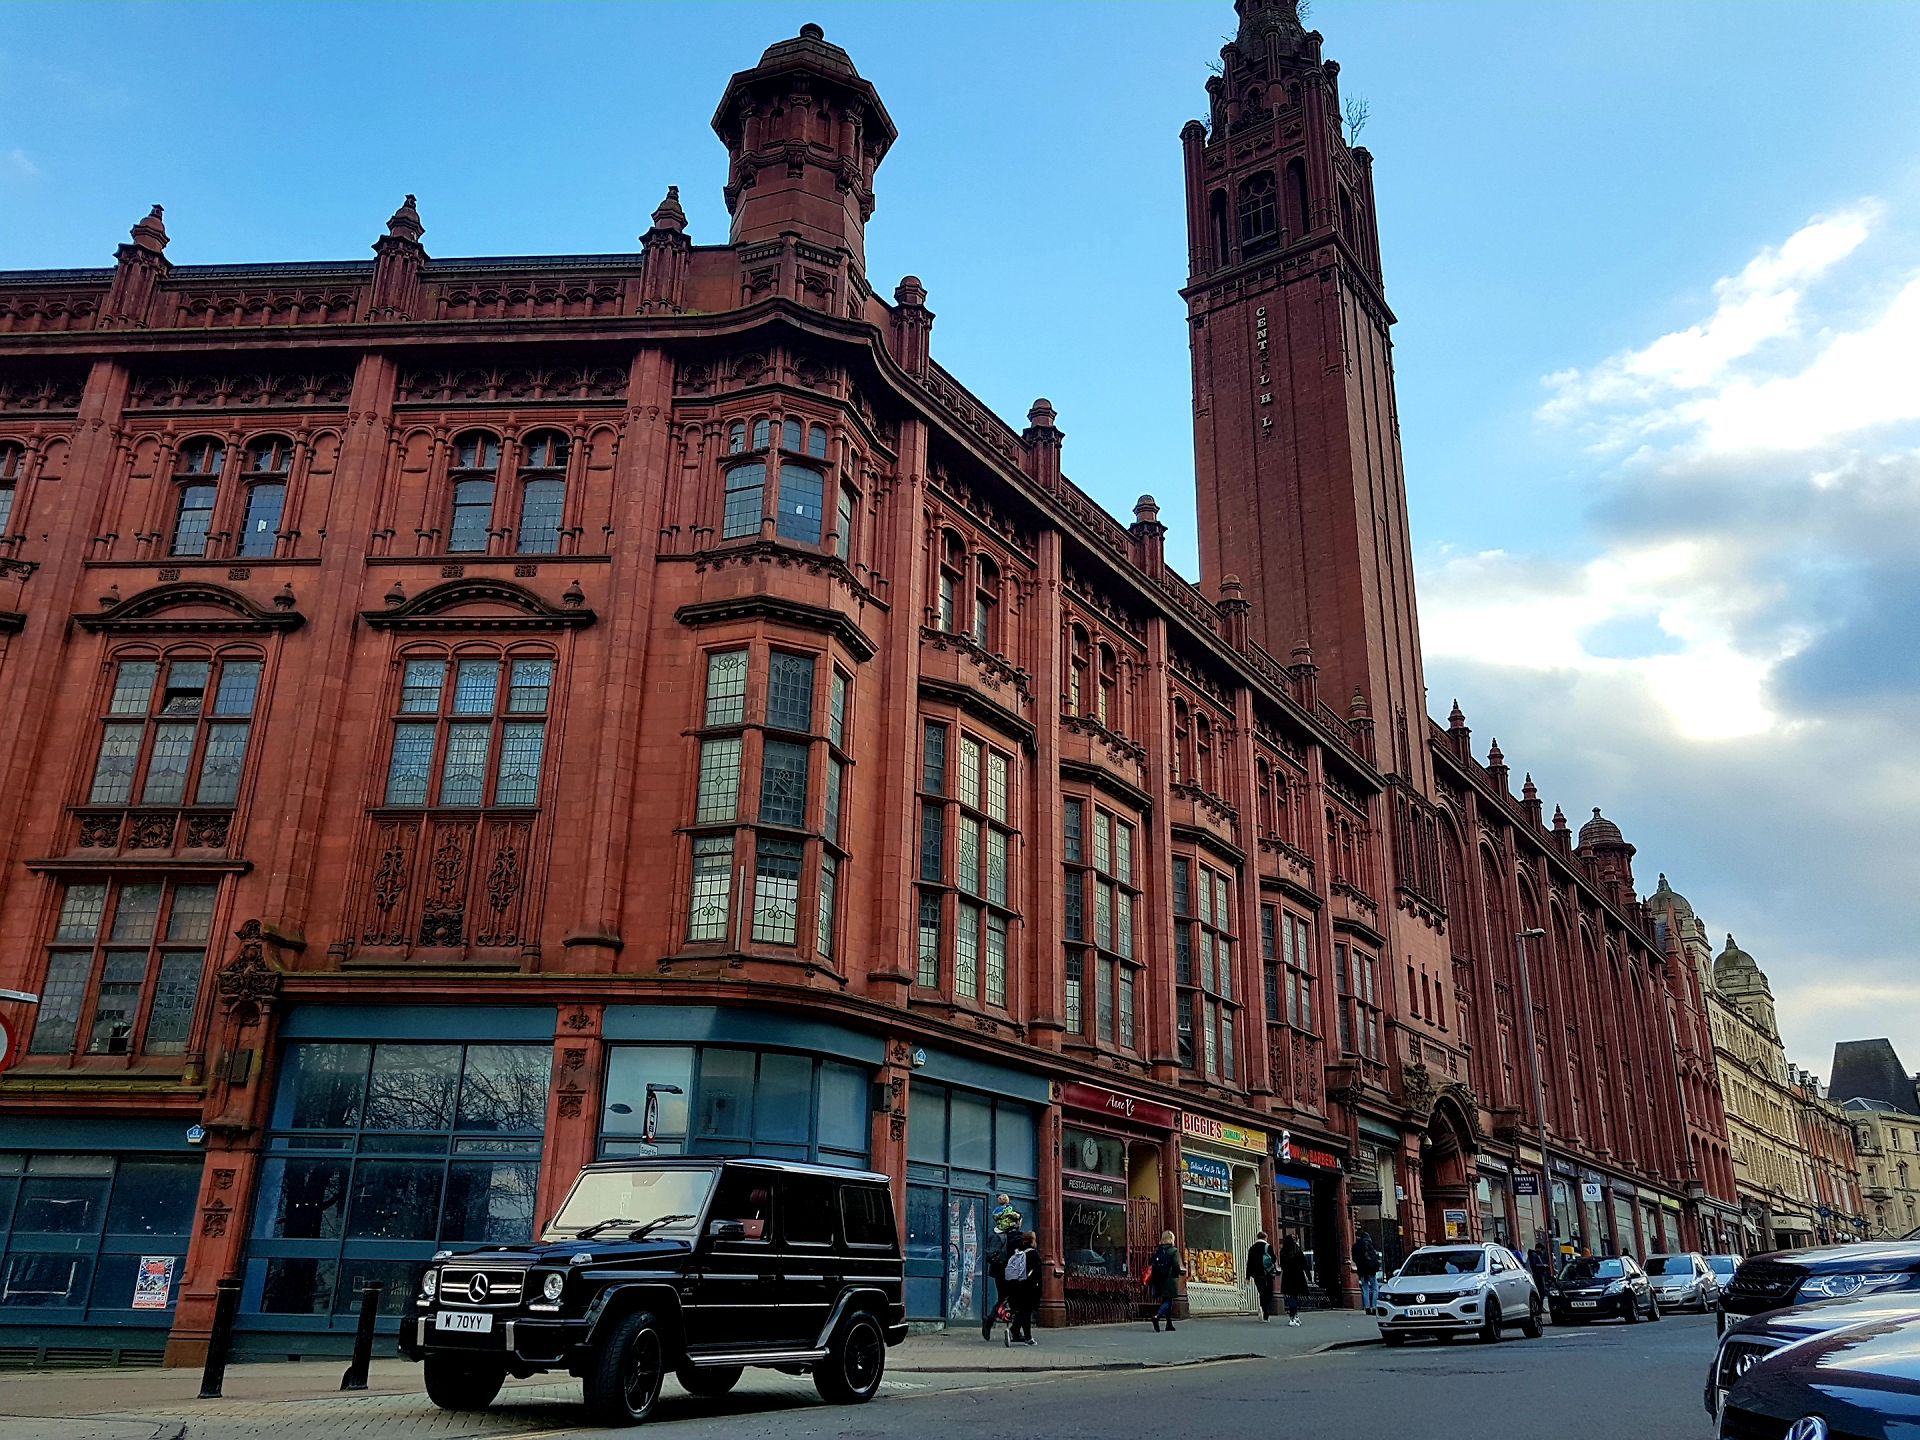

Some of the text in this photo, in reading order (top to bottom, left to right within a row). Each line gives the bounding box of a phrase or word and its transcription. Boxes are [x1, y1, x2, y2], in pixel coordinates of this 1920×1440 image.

[1183, 1113, 1222, 1139] BIGGIE'S
[1068, 1179, 1113, 1195] RESTAURANT BAR
[444, 1314, 483, 1329] W 70YY
